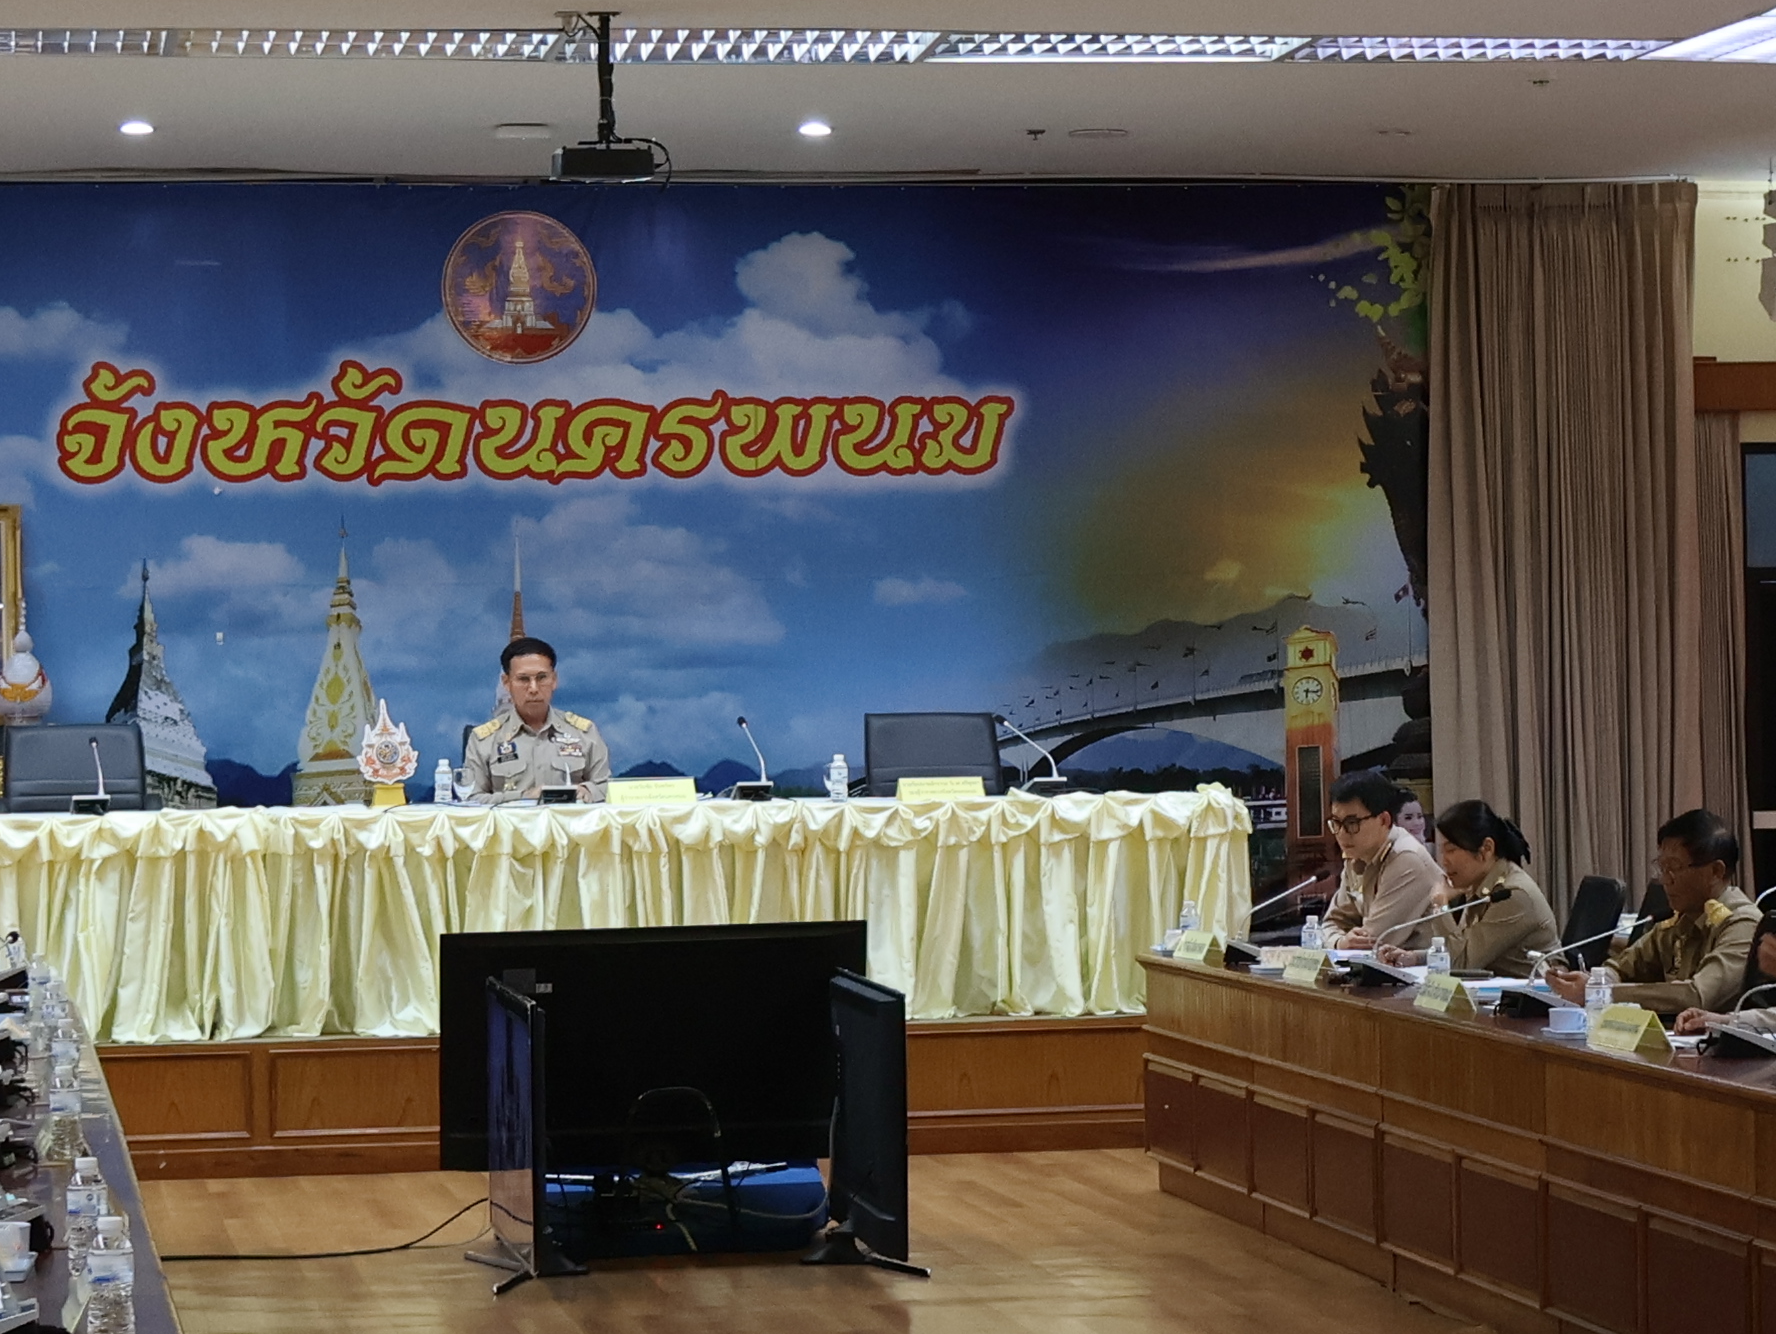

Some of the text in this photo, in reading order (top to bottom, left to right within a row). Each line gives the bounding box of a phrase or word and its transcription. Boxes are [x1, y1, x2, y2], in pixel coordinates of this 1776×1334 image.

[57, 359, 1015, 486] จังหวัดนครพนม
